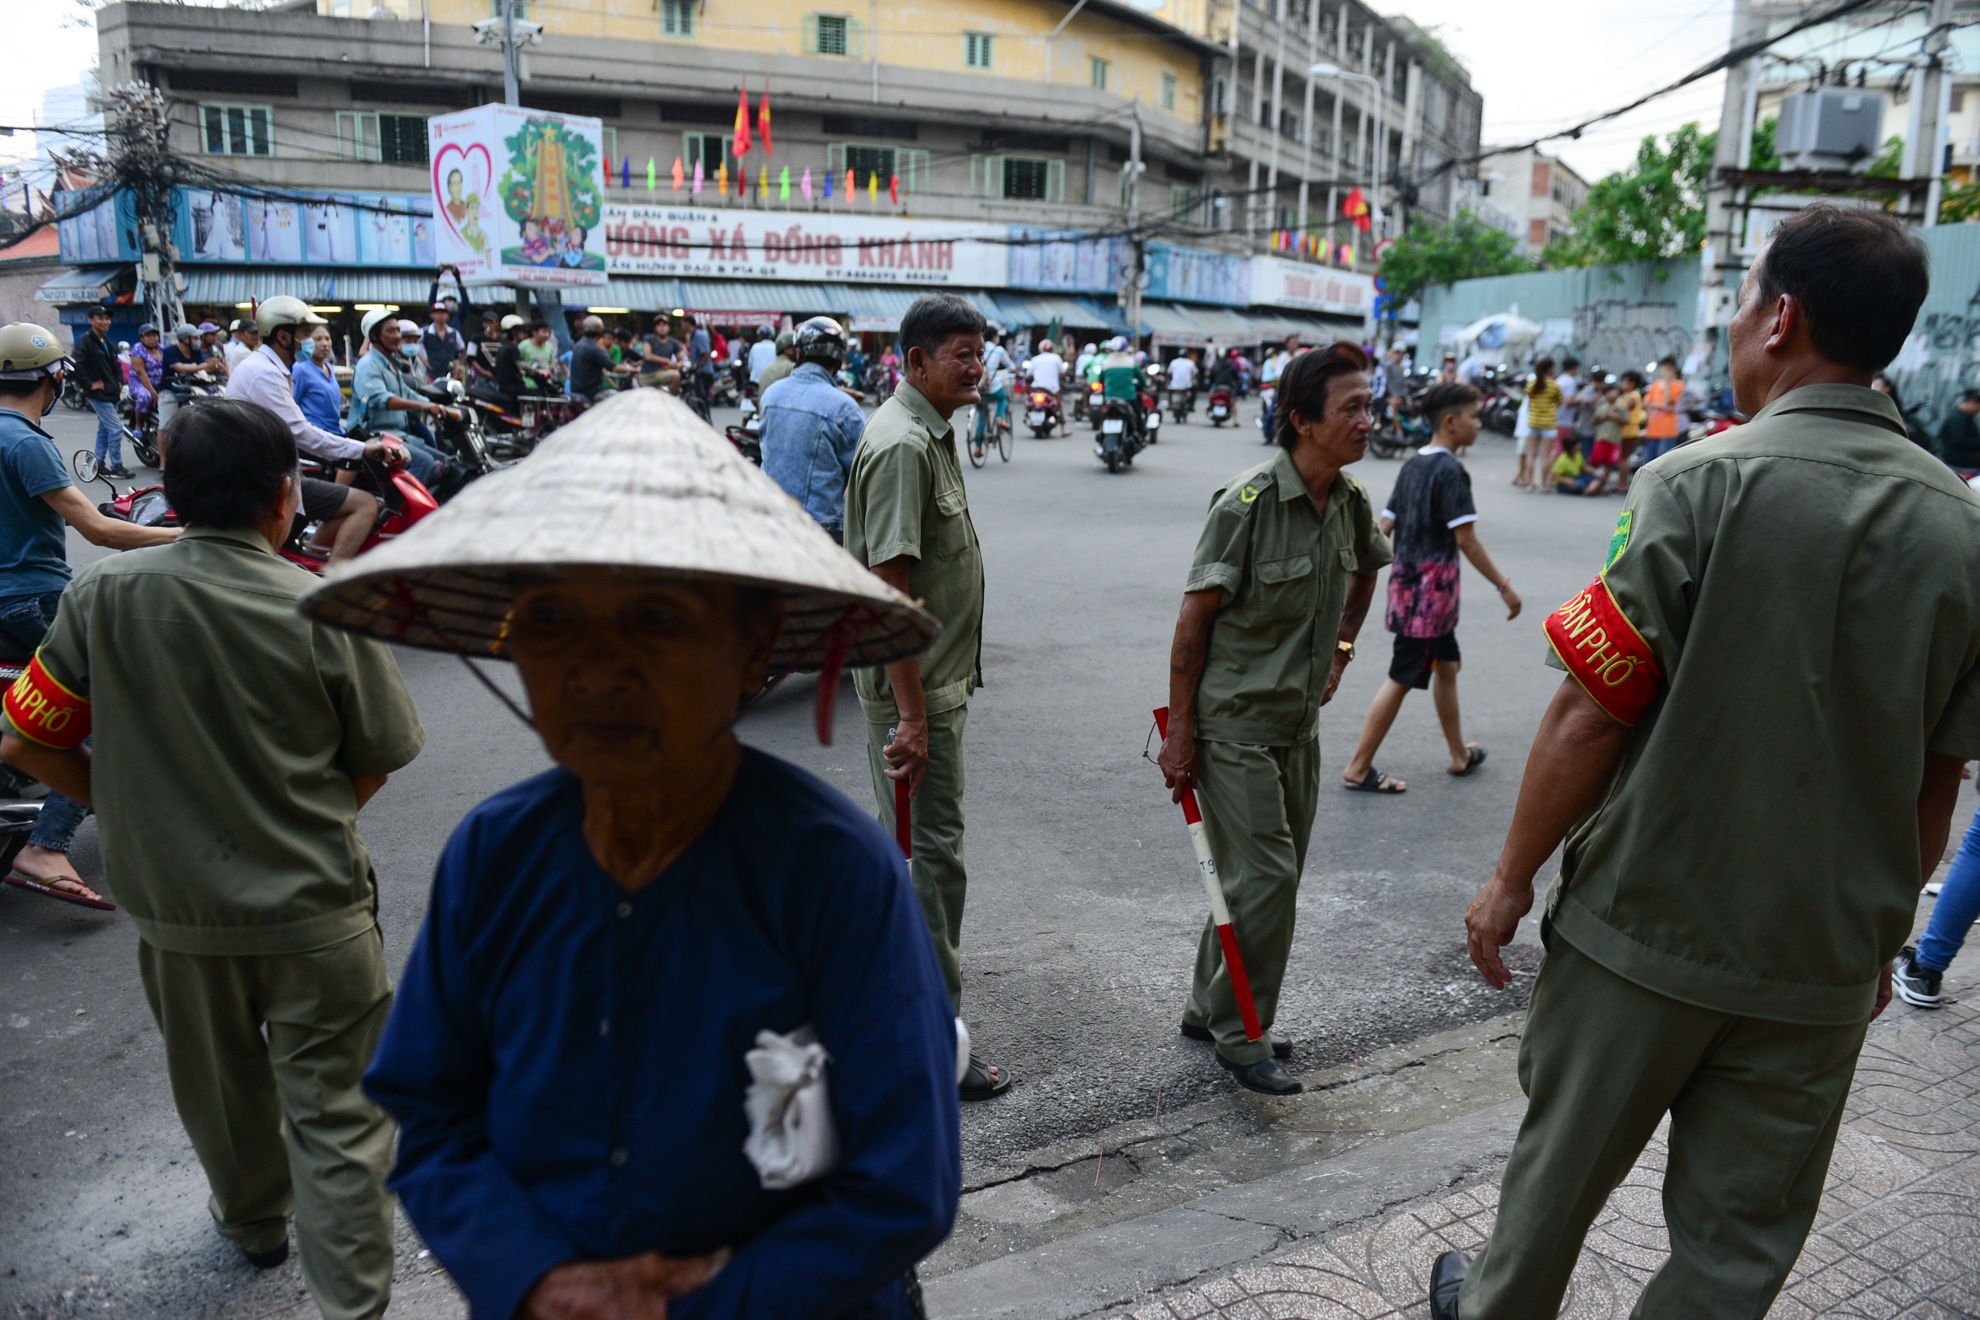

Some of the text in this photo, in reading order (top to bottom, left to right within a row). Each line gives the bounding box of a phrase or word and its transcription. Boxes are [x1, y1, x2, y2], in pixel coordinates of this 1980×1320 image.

[604, 206, 626, 218] ÂN
[709, 222, 748, 261] XÁ
[858, 231, 953, 270] KHÁNH
[1576, 627, 1646, 688] PHỐ
